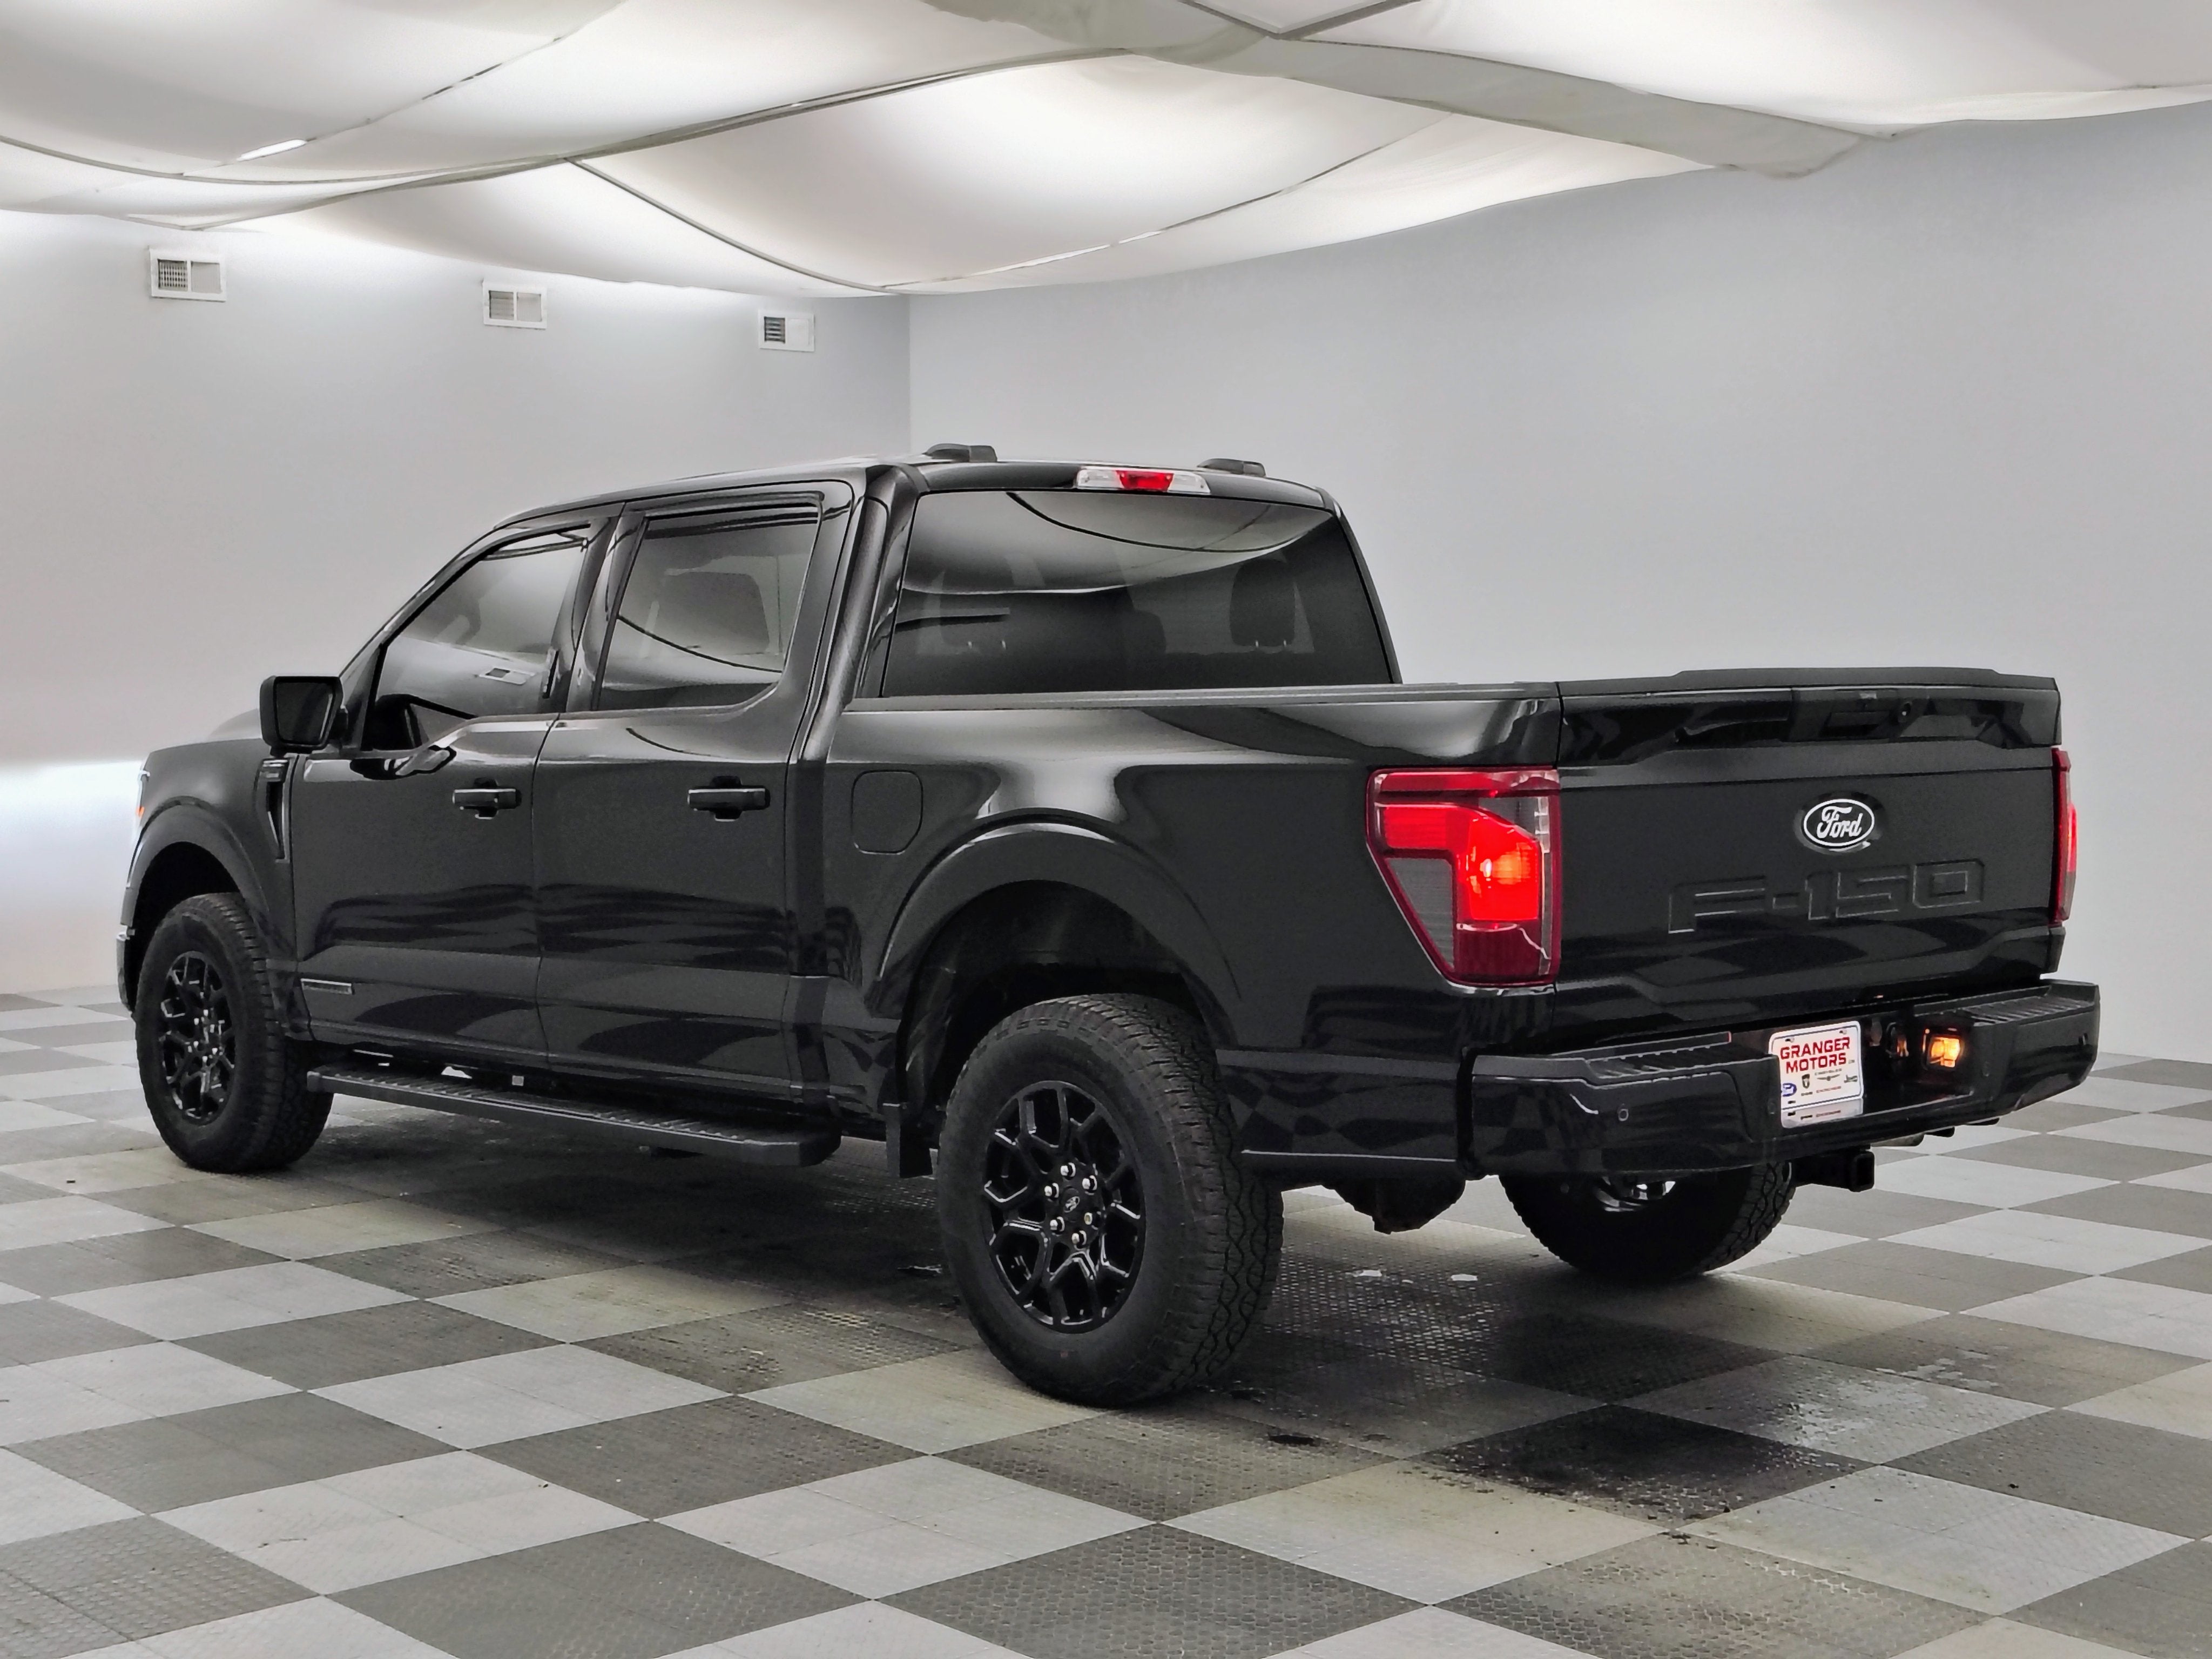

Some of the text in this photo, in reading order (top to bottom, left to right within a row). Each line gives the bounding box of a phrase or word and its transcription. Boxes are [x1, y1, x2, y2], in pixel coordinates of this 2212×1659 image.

[1817, 806, 1863, 838] Ford
[1668, 859, 1985, 934] F-150
[1780, 1037, 1850, 1060] GRANGER
[1786, 1053, 1846, 1074] MOTORS
